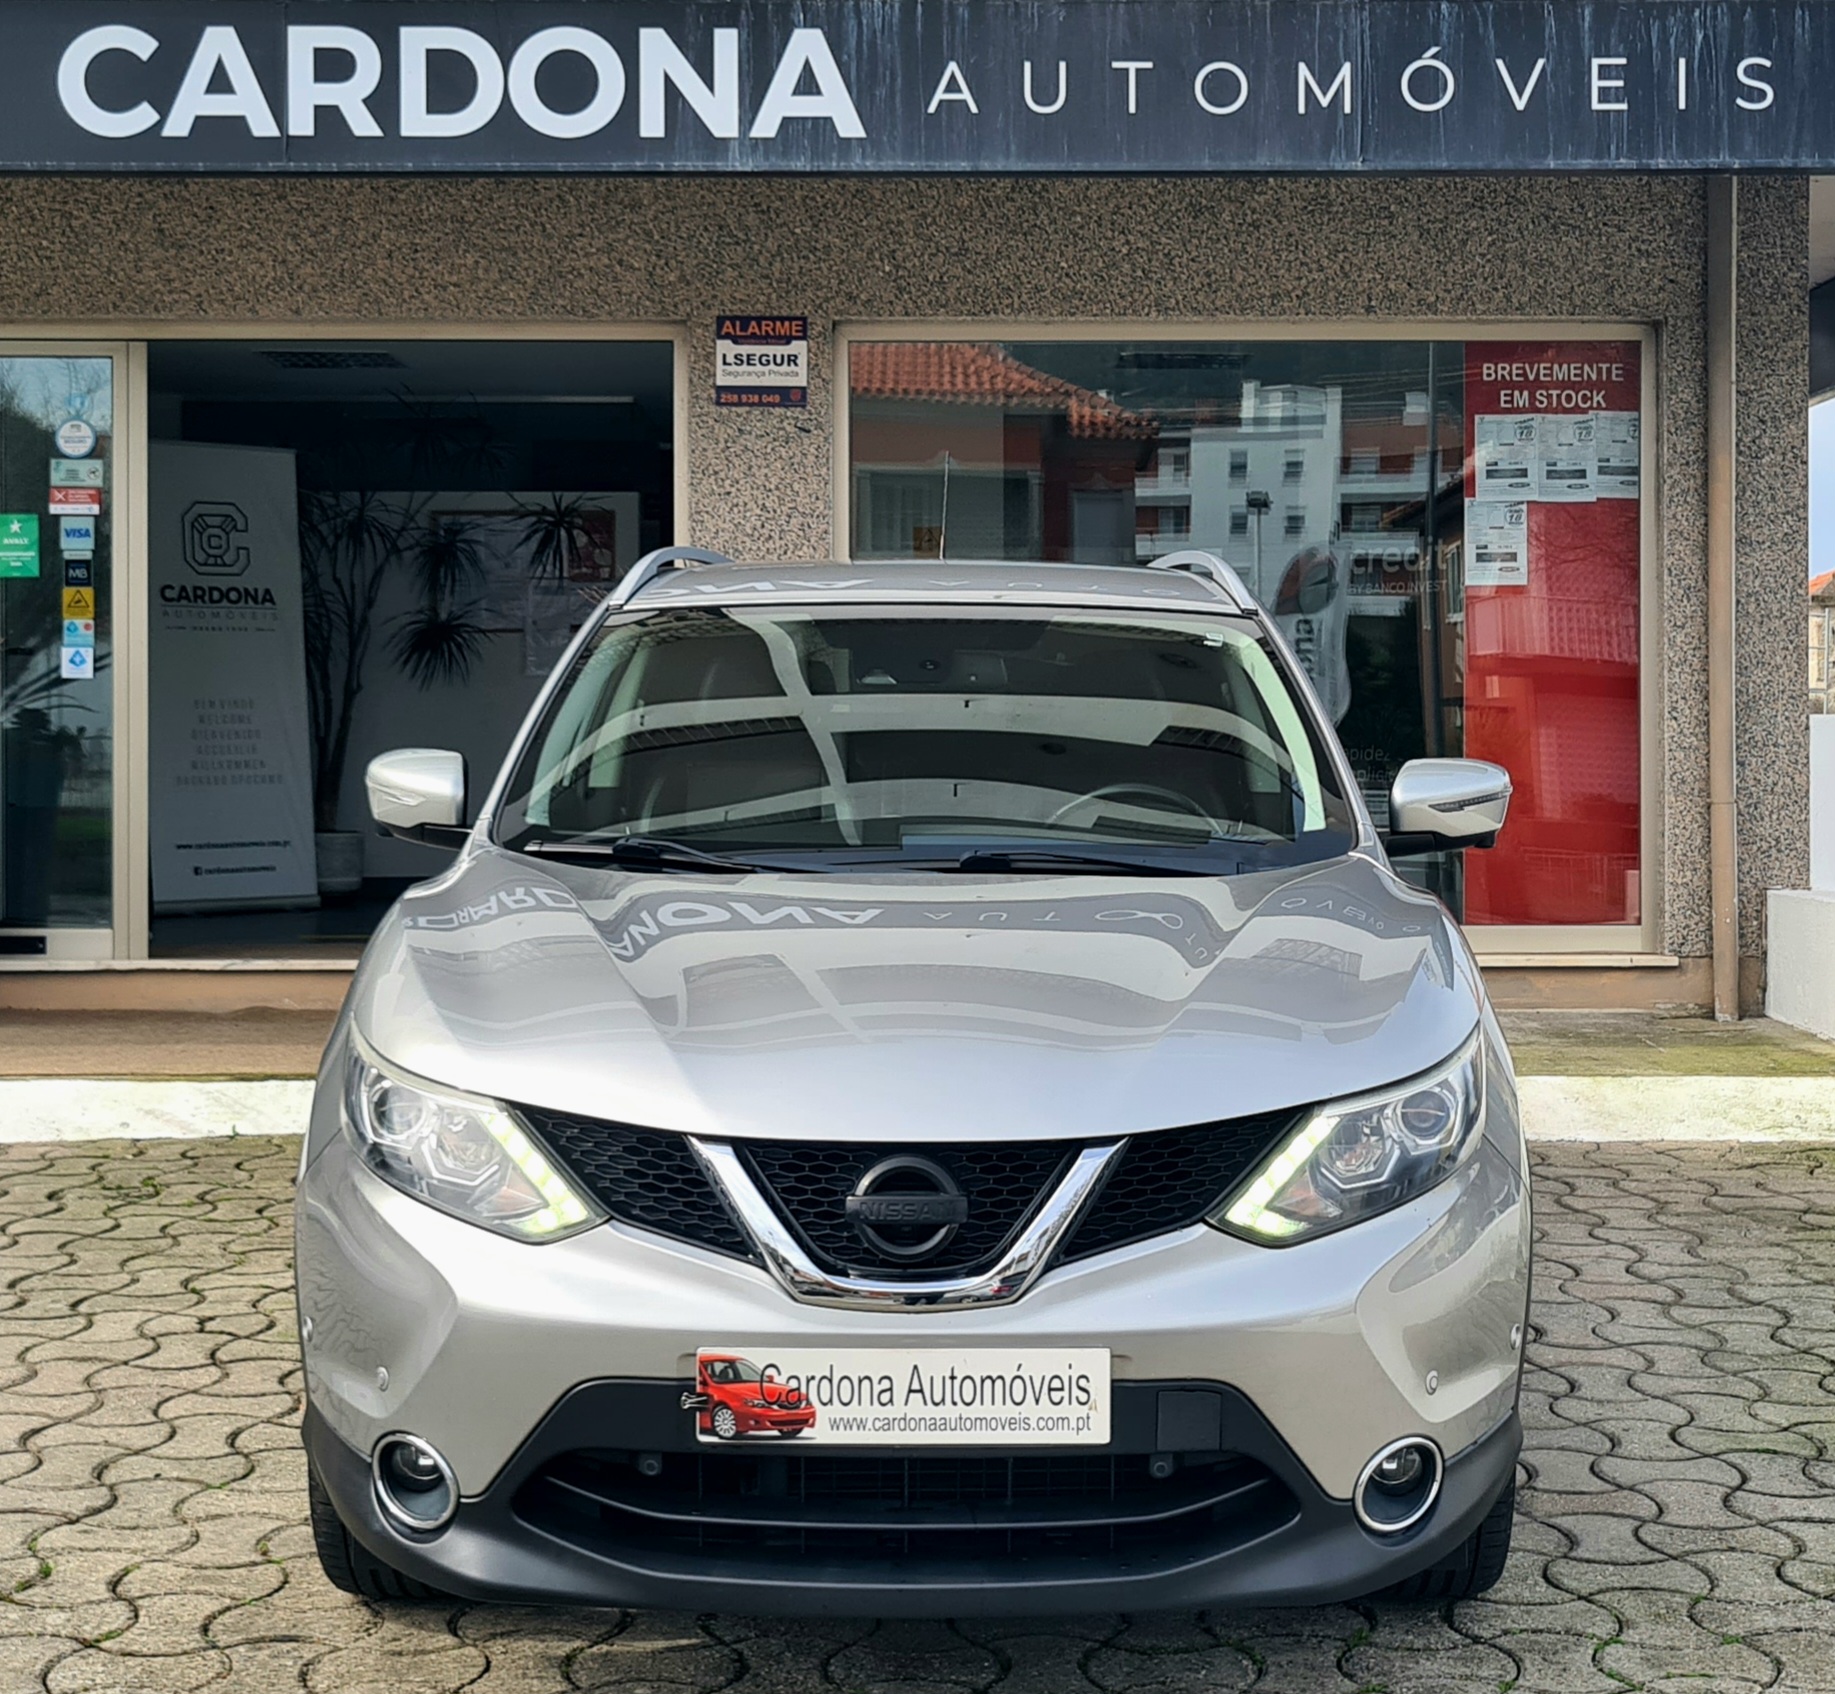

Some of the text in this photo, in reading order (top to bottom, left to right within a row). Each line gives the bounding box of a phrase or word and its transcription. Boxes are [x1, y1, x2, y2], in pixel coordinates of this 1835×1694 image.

[58, 26, 1774, 138] CARDONA AUTOMÓVEIS
[721, 320, 803, 336] ALARME
[722, 353, 799, 367] LSEGUR
[722, 369, 799, 378] Segurança Privada
[1482, 363, 1624, 381] BREVEMENTE
[1500, 390, 1607, 408] EM STOCK
[64, 528, 91, 538] VISA
[68, 568, 88, 579] MB
[160, 584, 277, 606] CARDONA
[760, 1363, 1091, 1407] Cardona Automóveis
[828, 1412, 1091, 1435] www.cardonaautomoveis.com.pt
